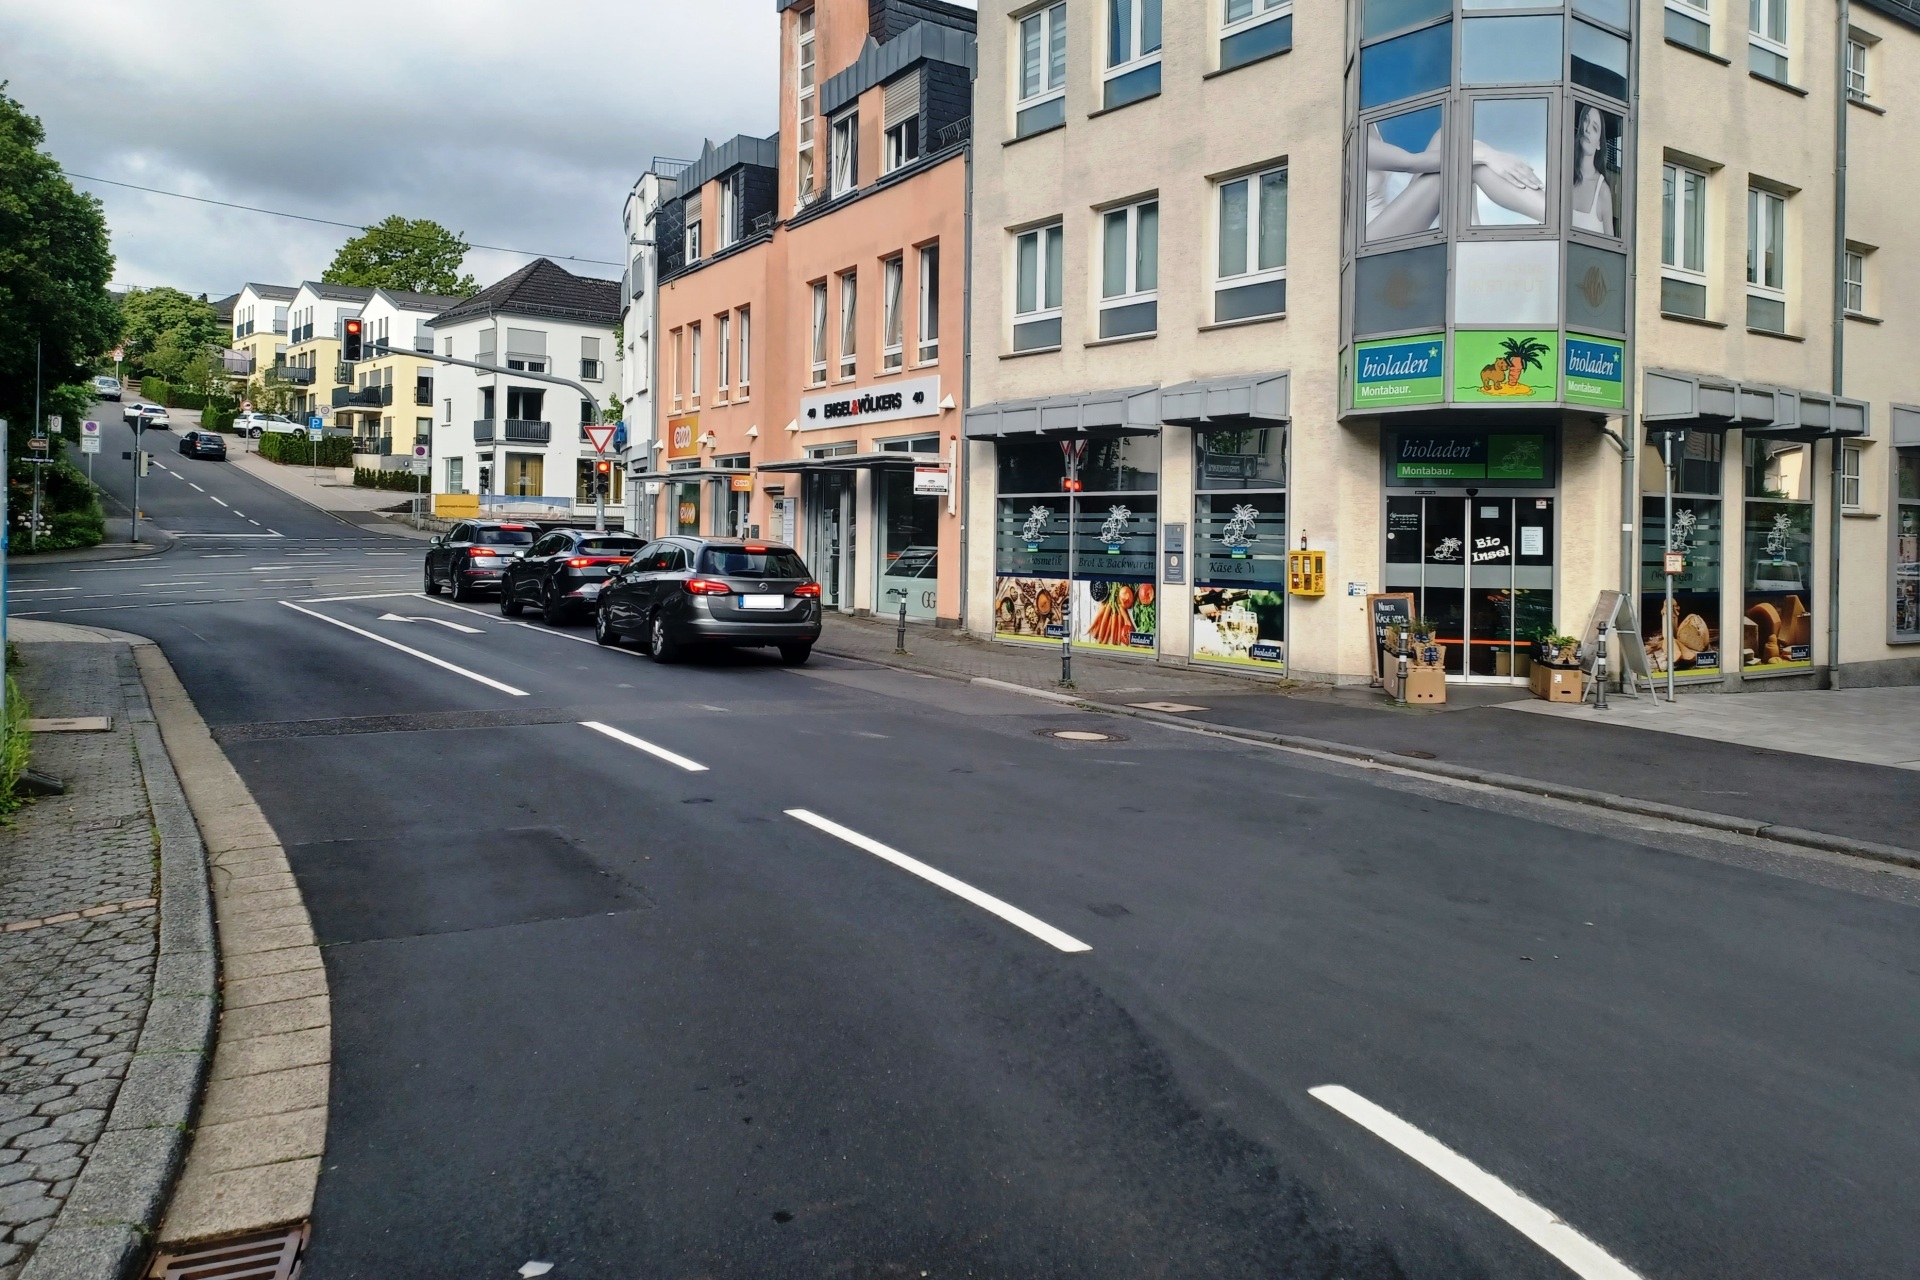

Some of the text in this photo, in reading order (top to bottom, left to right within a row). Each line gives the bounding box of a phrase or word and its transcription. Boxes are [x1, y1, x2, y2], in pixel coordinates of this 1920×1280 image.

[1362, 353, 1429, 379] bioladen
[1569, 349, 1614, 376] bioladen
[1361, 384, 1412, 397] Montabaur.
[1568, 380, 1603, 395] Montabaur.
[912, 391, 925, 404] 40
[312, 418, 320, 428] P
[1402, 439, 1471, 458] bioladen
[1402, 466, 1455, 476] Montabaur.
[774, 502, 783, 510] 40
[1474, 536, 1501, 549] Bio
[1471, 545, 1511, 563] Insel
[1078, 556, 1155, 570] Brot & Backwaren
[1209, 561, 1232, 573] Käse
[1234, 562, 1243, 574] &
[1131, 633, 1150, 645] bioladen
[1253, 646, 1277, 658] bioladen
